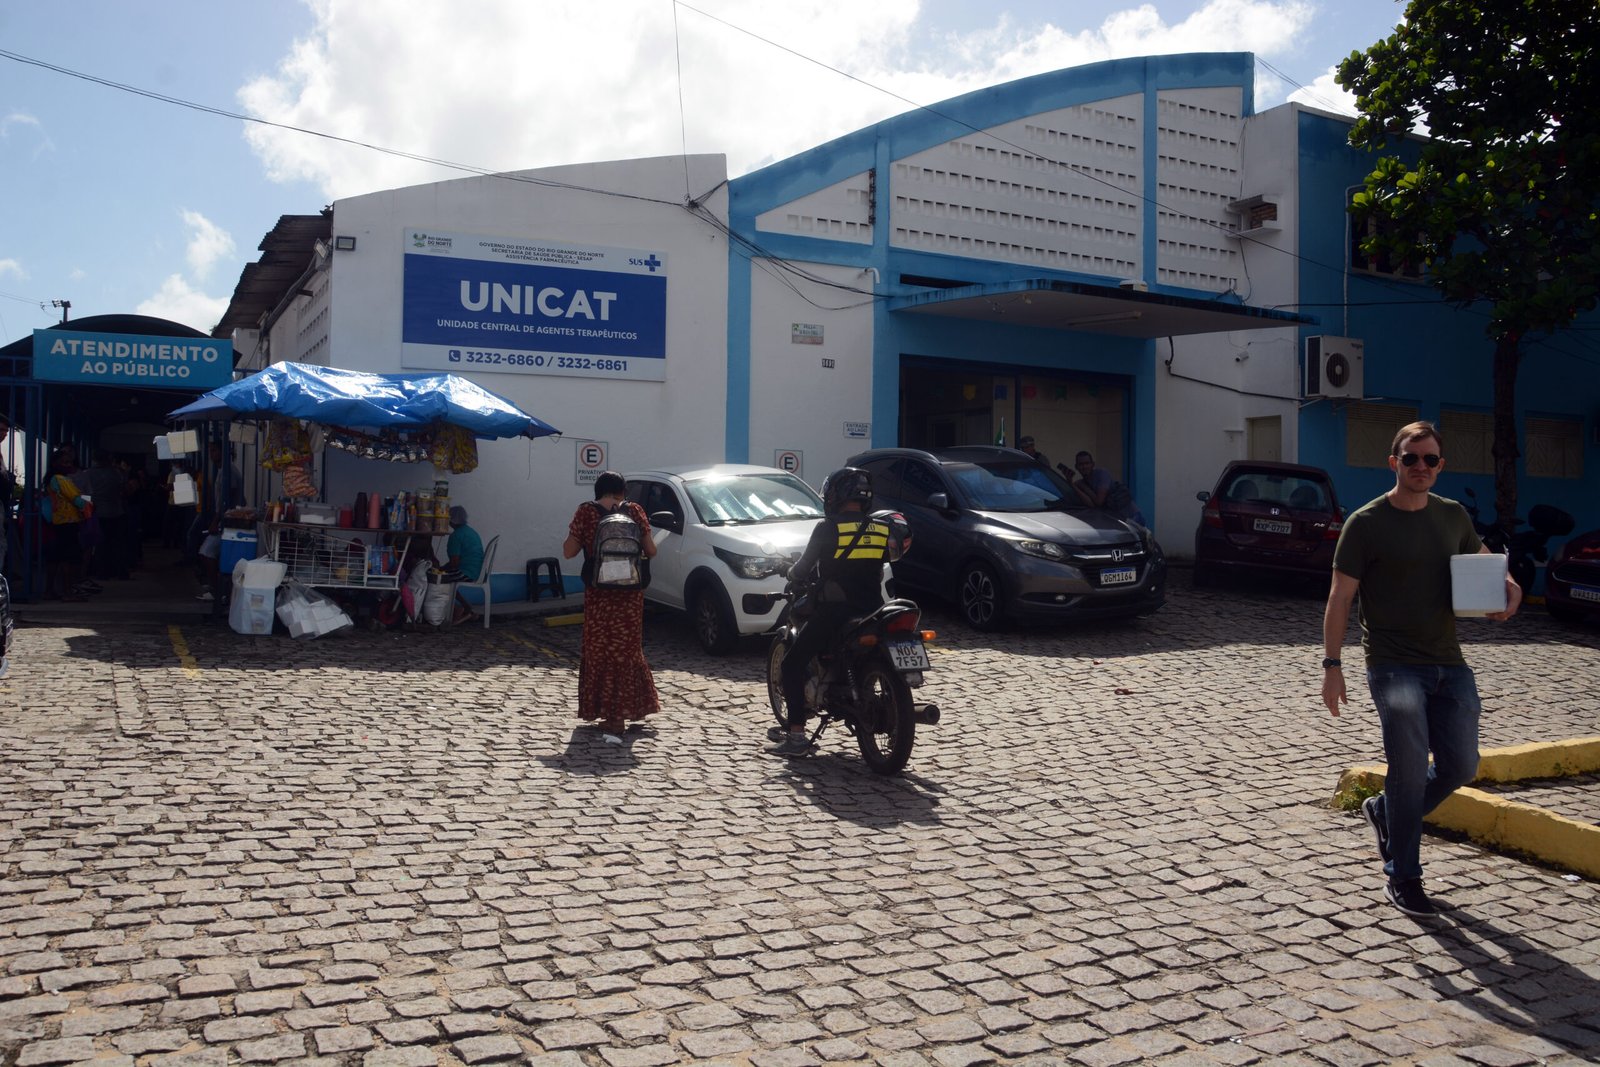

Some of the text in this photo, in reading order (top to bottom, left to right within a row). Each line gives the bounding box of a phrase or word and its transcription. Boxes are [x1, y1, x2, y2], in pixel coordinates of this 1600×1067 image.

[539, 257, 579, 265] FARMACÊUTICA
[628, 258, 644, 266] SUS
[460, 280, 617, 321] UNICAT
[437, 319, 637, 340] UNIDADE CENTRAL DE AGENTES TERAPÊUTICOS
[50, 338, 218, 362] ATENDIMENTO
[81, 360, 190, 378] AO PÚBLICO
[466, 352, 628, 372] 3232-6860 / 3232-6861
[587, 449, 597, 463] E
[784, 457, 794, 470] E
[896, 656, 922, 666] 7F57
